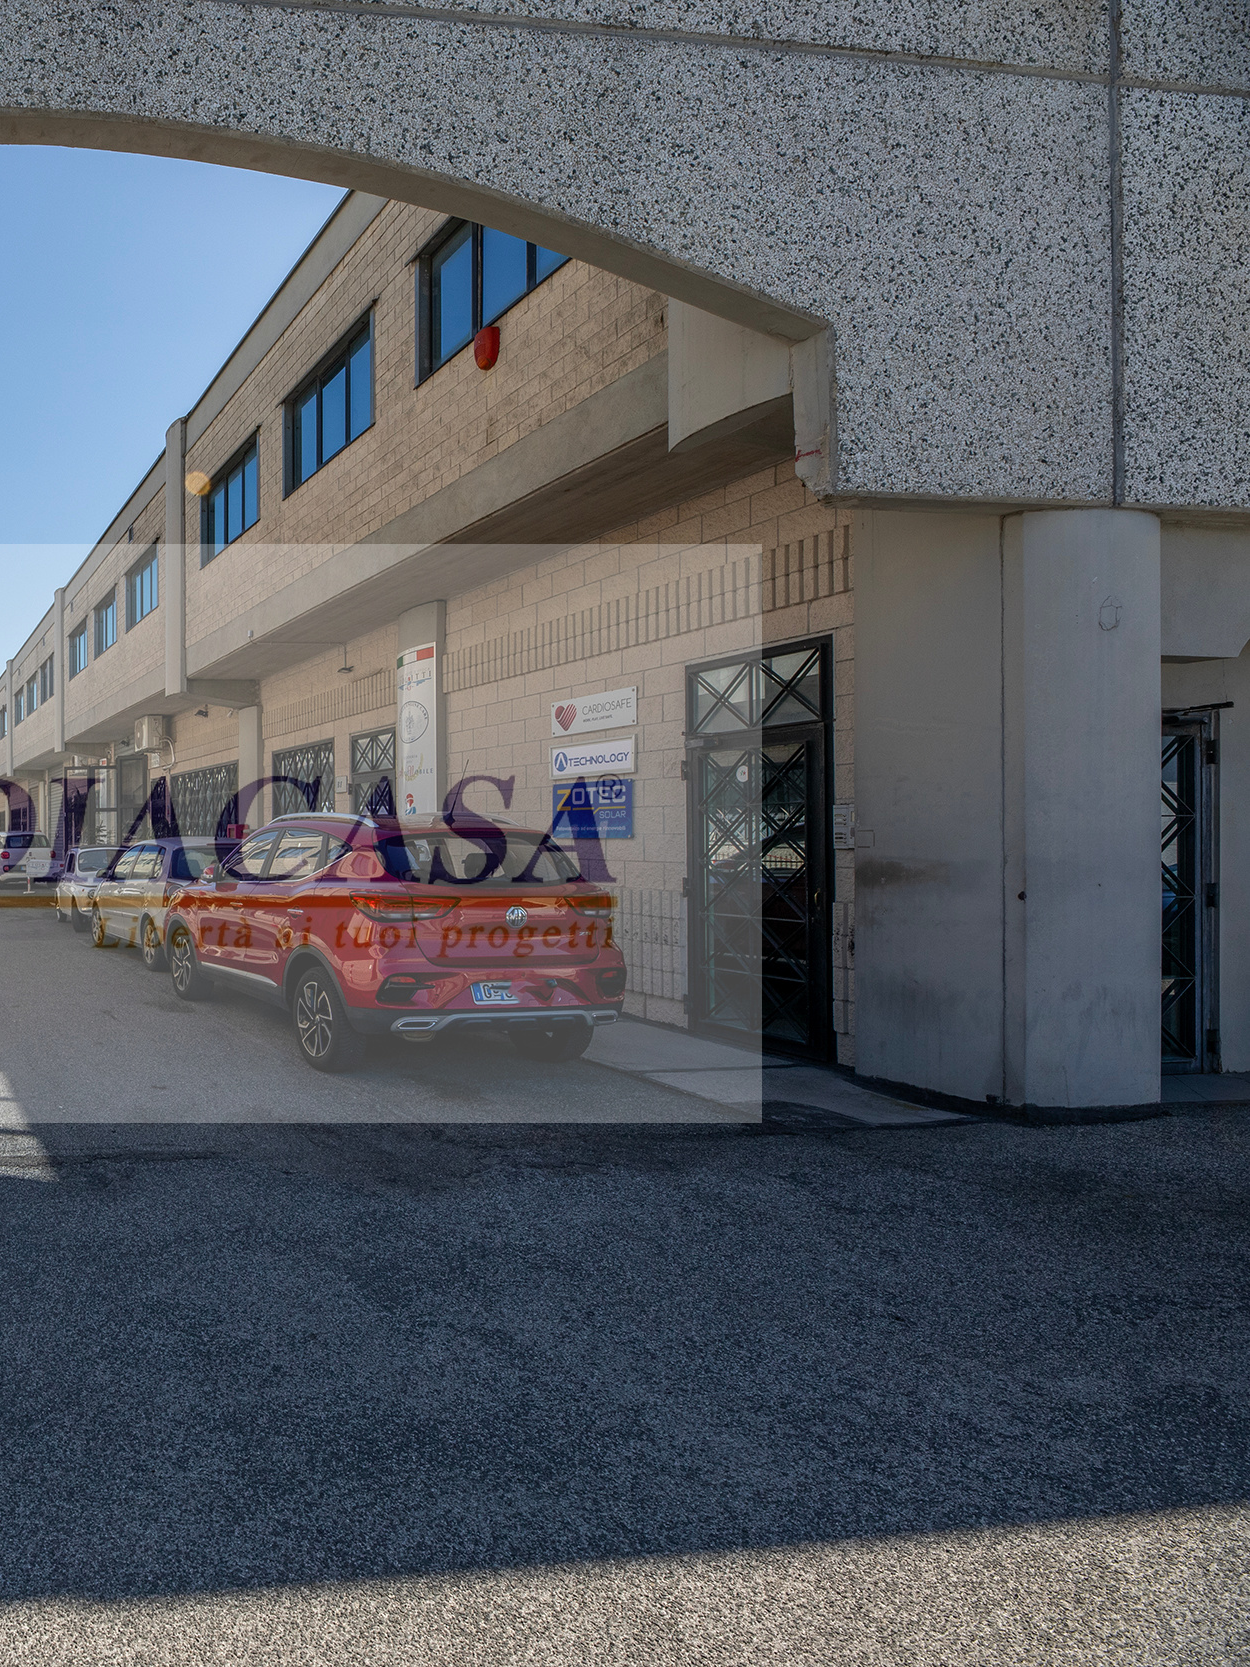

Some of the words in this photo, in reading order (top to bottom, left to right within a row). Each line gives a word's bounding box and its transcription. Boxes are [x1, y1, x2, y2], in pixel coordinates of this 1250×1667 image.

[582, 697, 632, 716] CARDIOSAFE
[556, 785, 627, 812] ZOTEC
[599, 810, 627, 819] SOLAR
